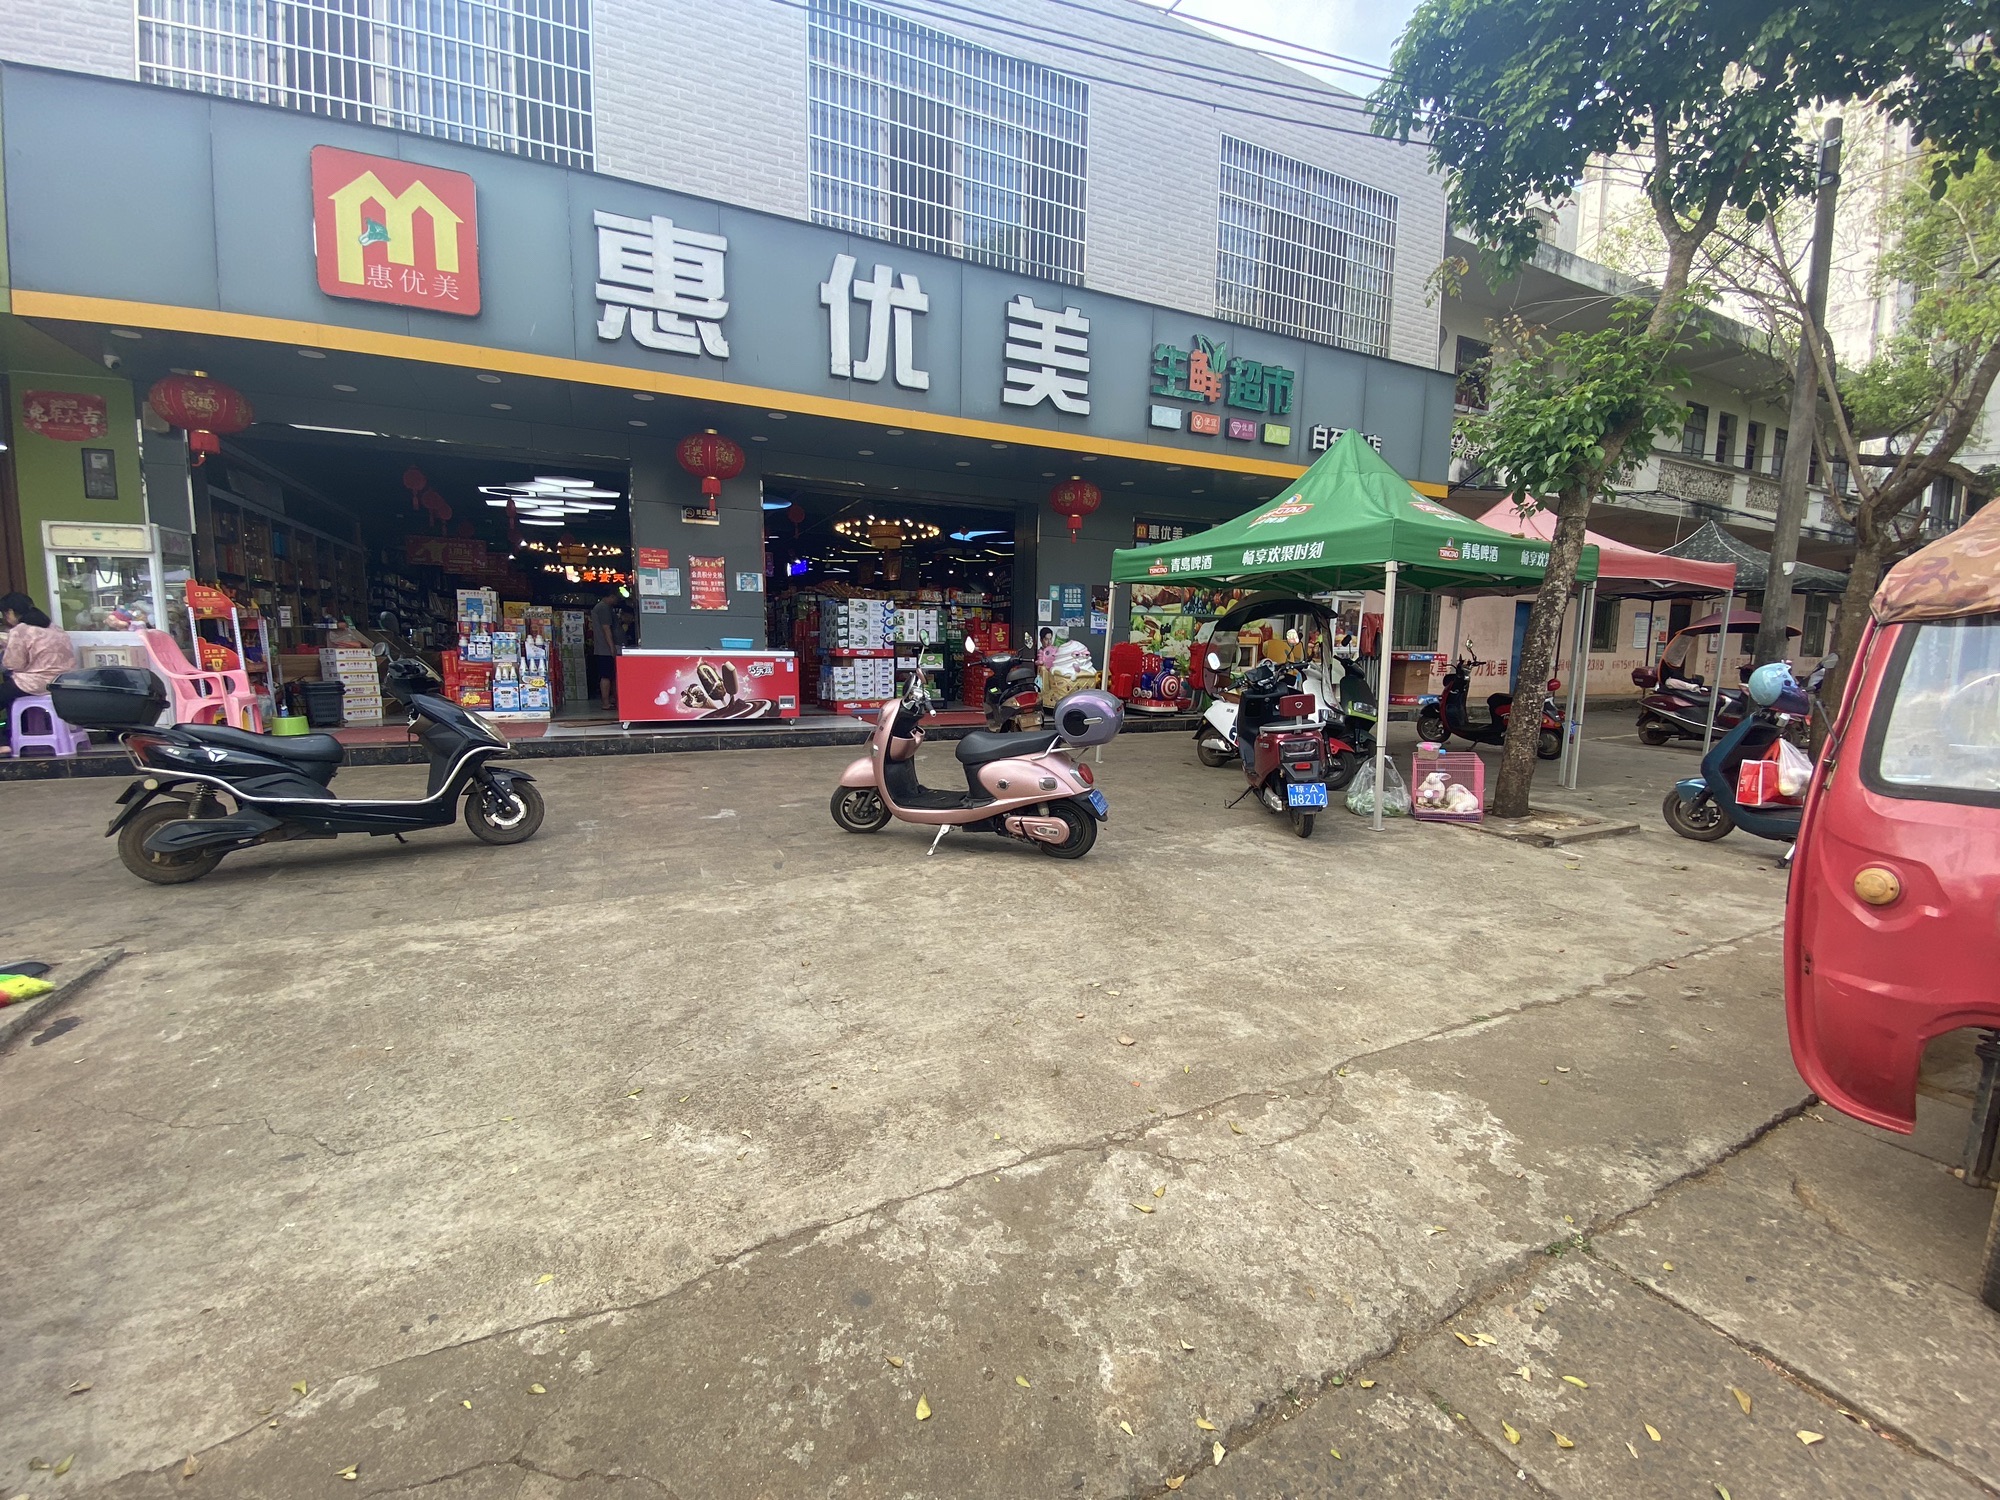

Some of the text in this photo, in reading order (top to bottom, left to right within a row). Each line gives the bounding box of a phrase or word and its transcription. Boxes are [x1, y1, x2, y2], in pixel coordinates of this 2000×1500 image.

[367, 263, 460, 301] 惠优美
[593, 208, 1092, 416] 惠优美
[1151, 342, 1296, 415] 生鲜超市
[1204, 417, 1218, 427] 便宜
[1241, 423, 1254, 432] 优质
[1312, 424, 1383, 454] 白石店
[1148, 524, 1183, 542] 惠优美
[1241, 540, 1325, 567] 畅享欢聚时刻
[1461, 542, 1499, 563] 青岛啤酒
[1170, 554, 1213, 573] 青岛啤酒
[994, 627, 1007, 643] 吉
[1295, 784, 1319, 793] 琼·A
[1290, 793, 1326, 805] H8212
